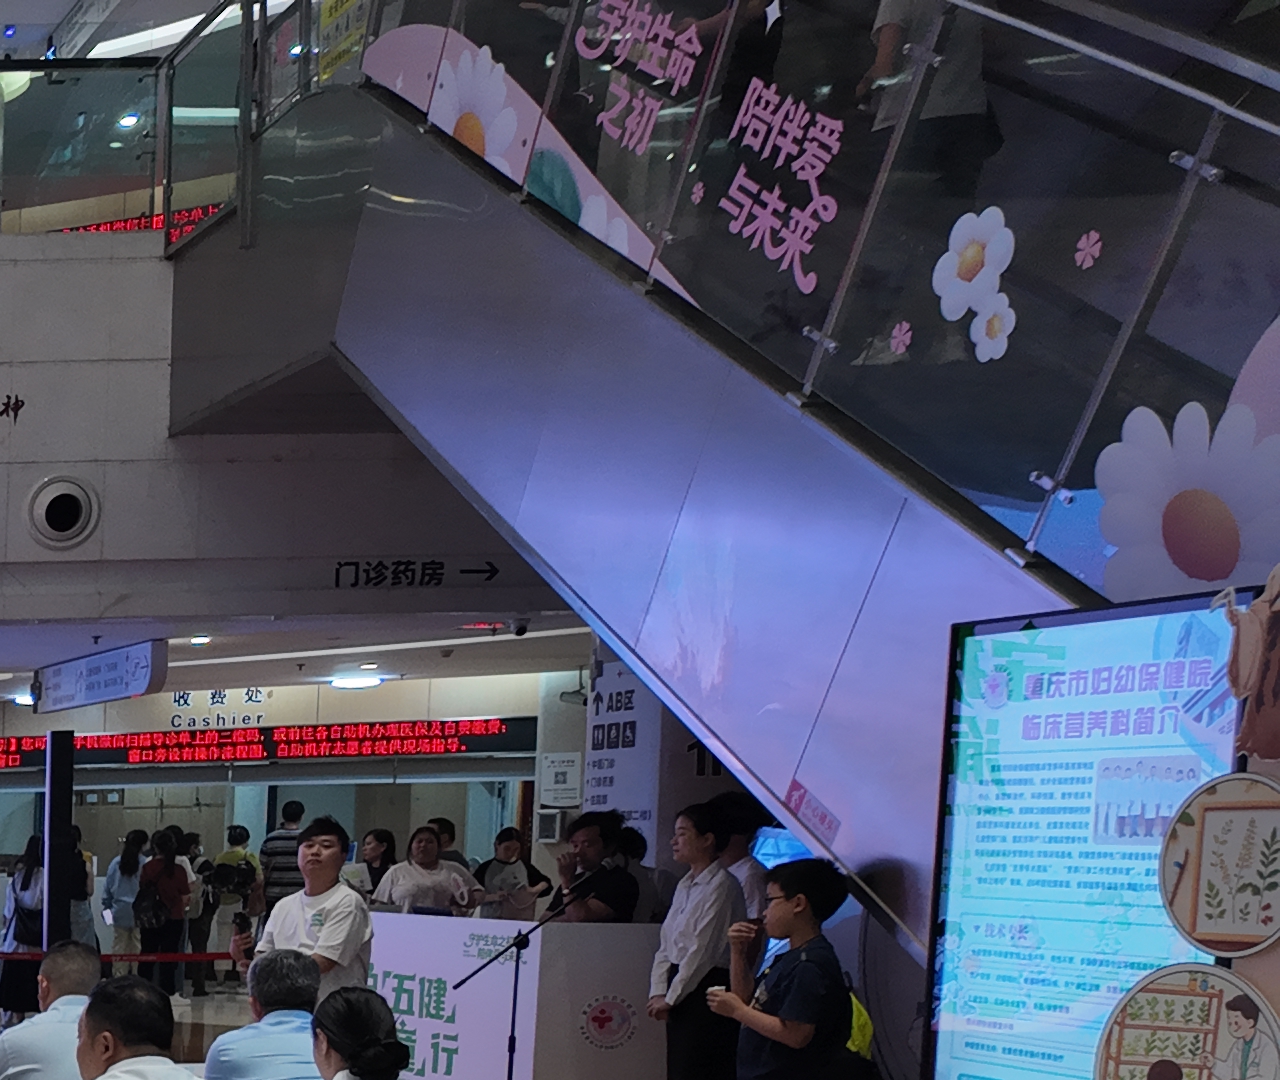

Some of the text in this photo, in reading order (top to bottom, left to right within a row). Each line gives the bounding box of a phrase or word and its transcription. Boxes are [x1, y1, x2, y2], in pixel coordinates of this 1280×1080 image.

[595, 76, 665, 156] 之初
[717, 163, 819, 296] 与未来
[334, 559, 445, 588] 门诊药房
[1023, 658, 1215, 700] 重庆市妇幼保健院
[606, 688, 636, 714] AB区
[171, 713, 265, 729] Cashier
[1021, 704, 1182, 741] 临床营养科简介
